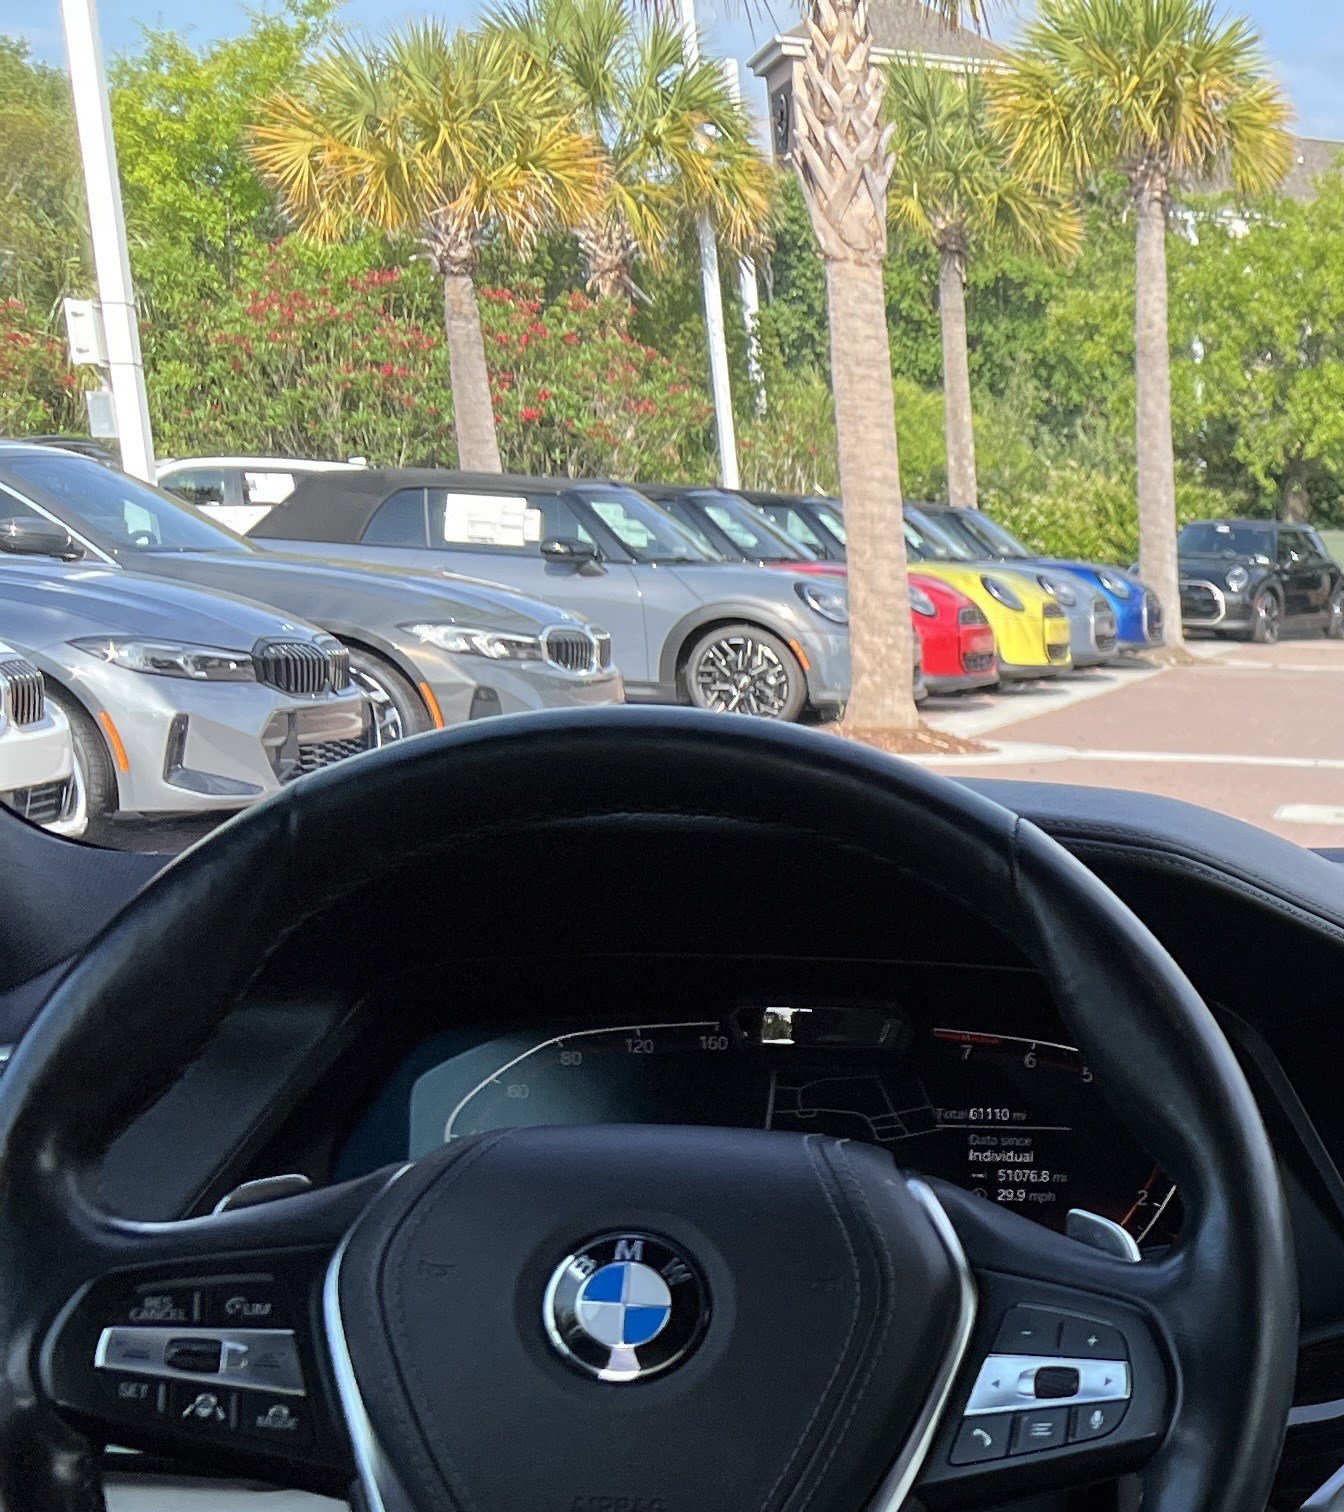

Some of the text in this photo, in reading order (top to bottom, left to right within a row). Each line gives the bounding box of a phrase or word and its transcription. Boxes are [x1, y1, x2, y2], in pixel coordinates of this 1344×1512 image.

[626, 1038, 654, 1054] 120
[960, 1045, 973, 1060] 7
[559, 1051, 583, 1066] 80
[1023, 1052, 1037, 1068] 6
[968, 1107, 1010, 1121] 61110
[968, 1134, 998, 1146] Data
[968, 1149, 1034, 1163] Individual
[997, 1168, 1050, 1183] 51076.8
[997, 1188, 1026, 1201] 29.9
[566, 1240, 693, 1286] BMW
